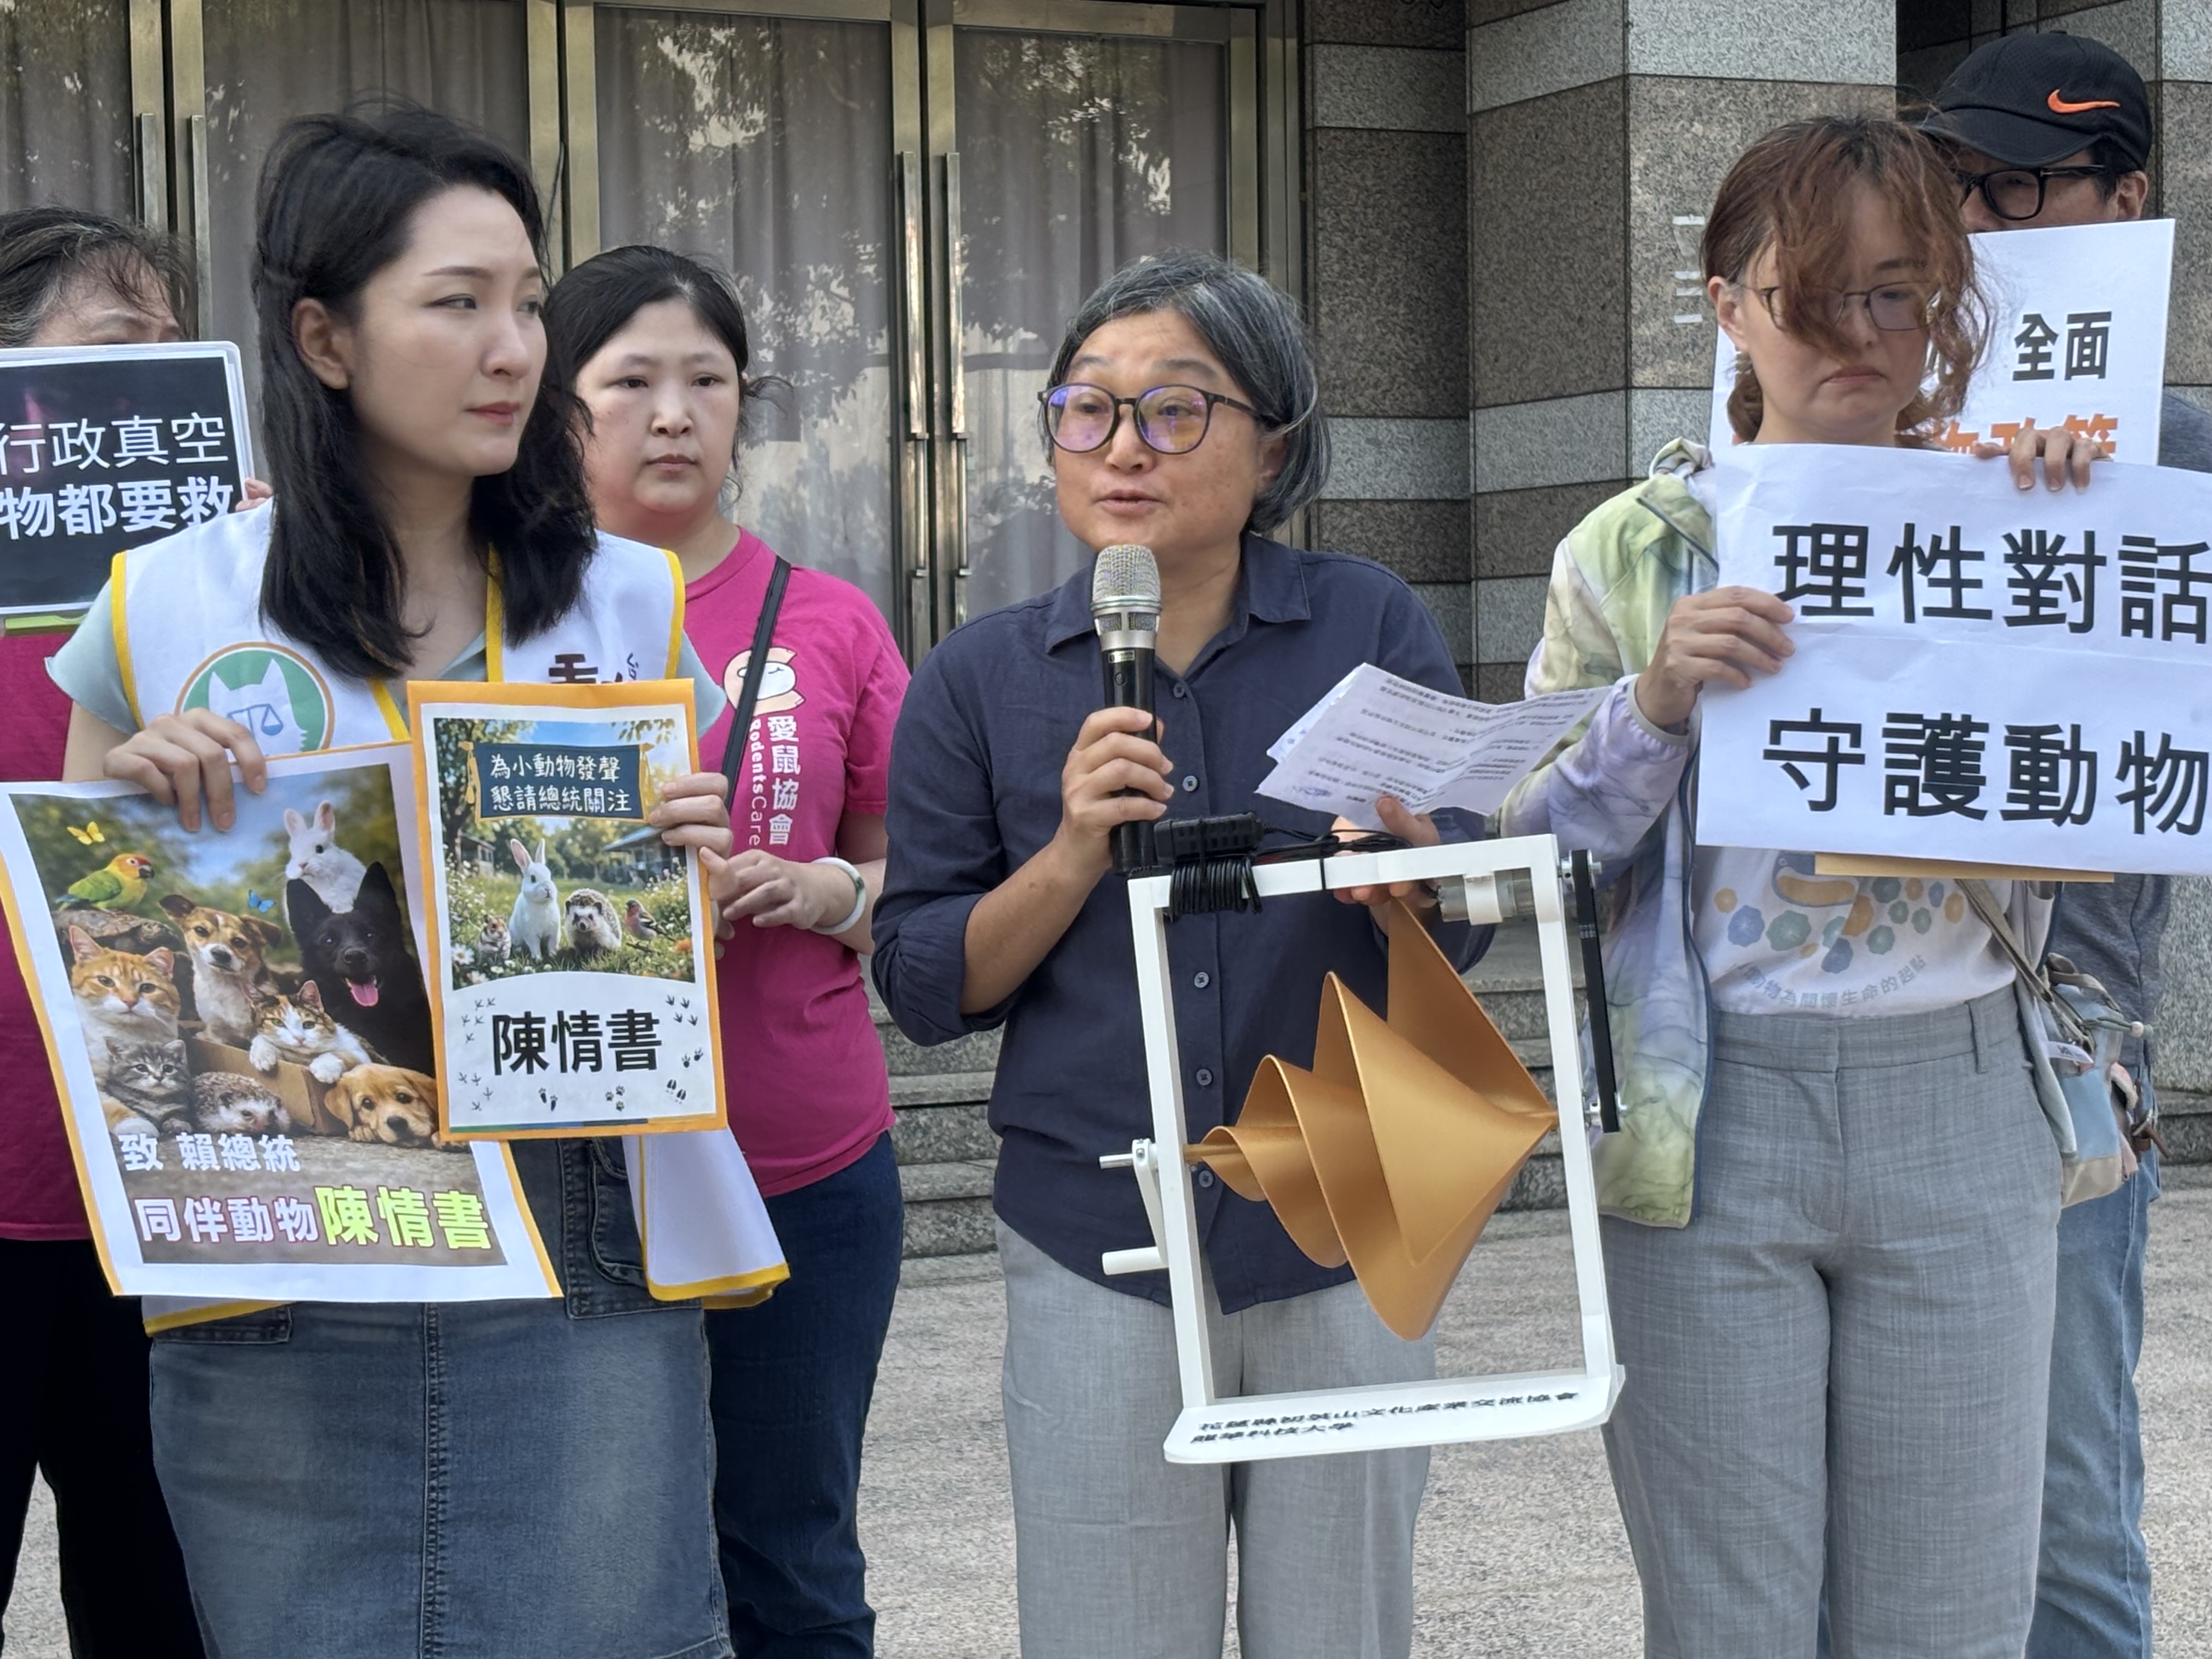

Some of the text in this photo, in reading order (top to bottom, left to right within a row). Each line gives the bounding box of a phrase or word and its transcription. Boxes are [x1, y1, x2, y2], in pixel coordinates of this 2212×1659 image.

[2012, 311, 2112, 381] 全面
[0, 412, 228, 475] 行政真空
[0, 476, 234, 540] 物都要救
[1772, 522, 2212, 644] 理性對話
[490, 753, 621, 783] 為小動物發聲
[490, 784, 632, 813] 懇請總統關注
[749, 718, 767, 846] RodentsCare
[767, 715, 801, 845] 愛鼠協會
[1762, 708, 2209, 836] 守護動物
[493, 1009, 662, 1076] 陳情書
[118, 1133, 301, 1172] 致 賴總統
[133, 1184, 492, 1250] 同伴動物陳情書
